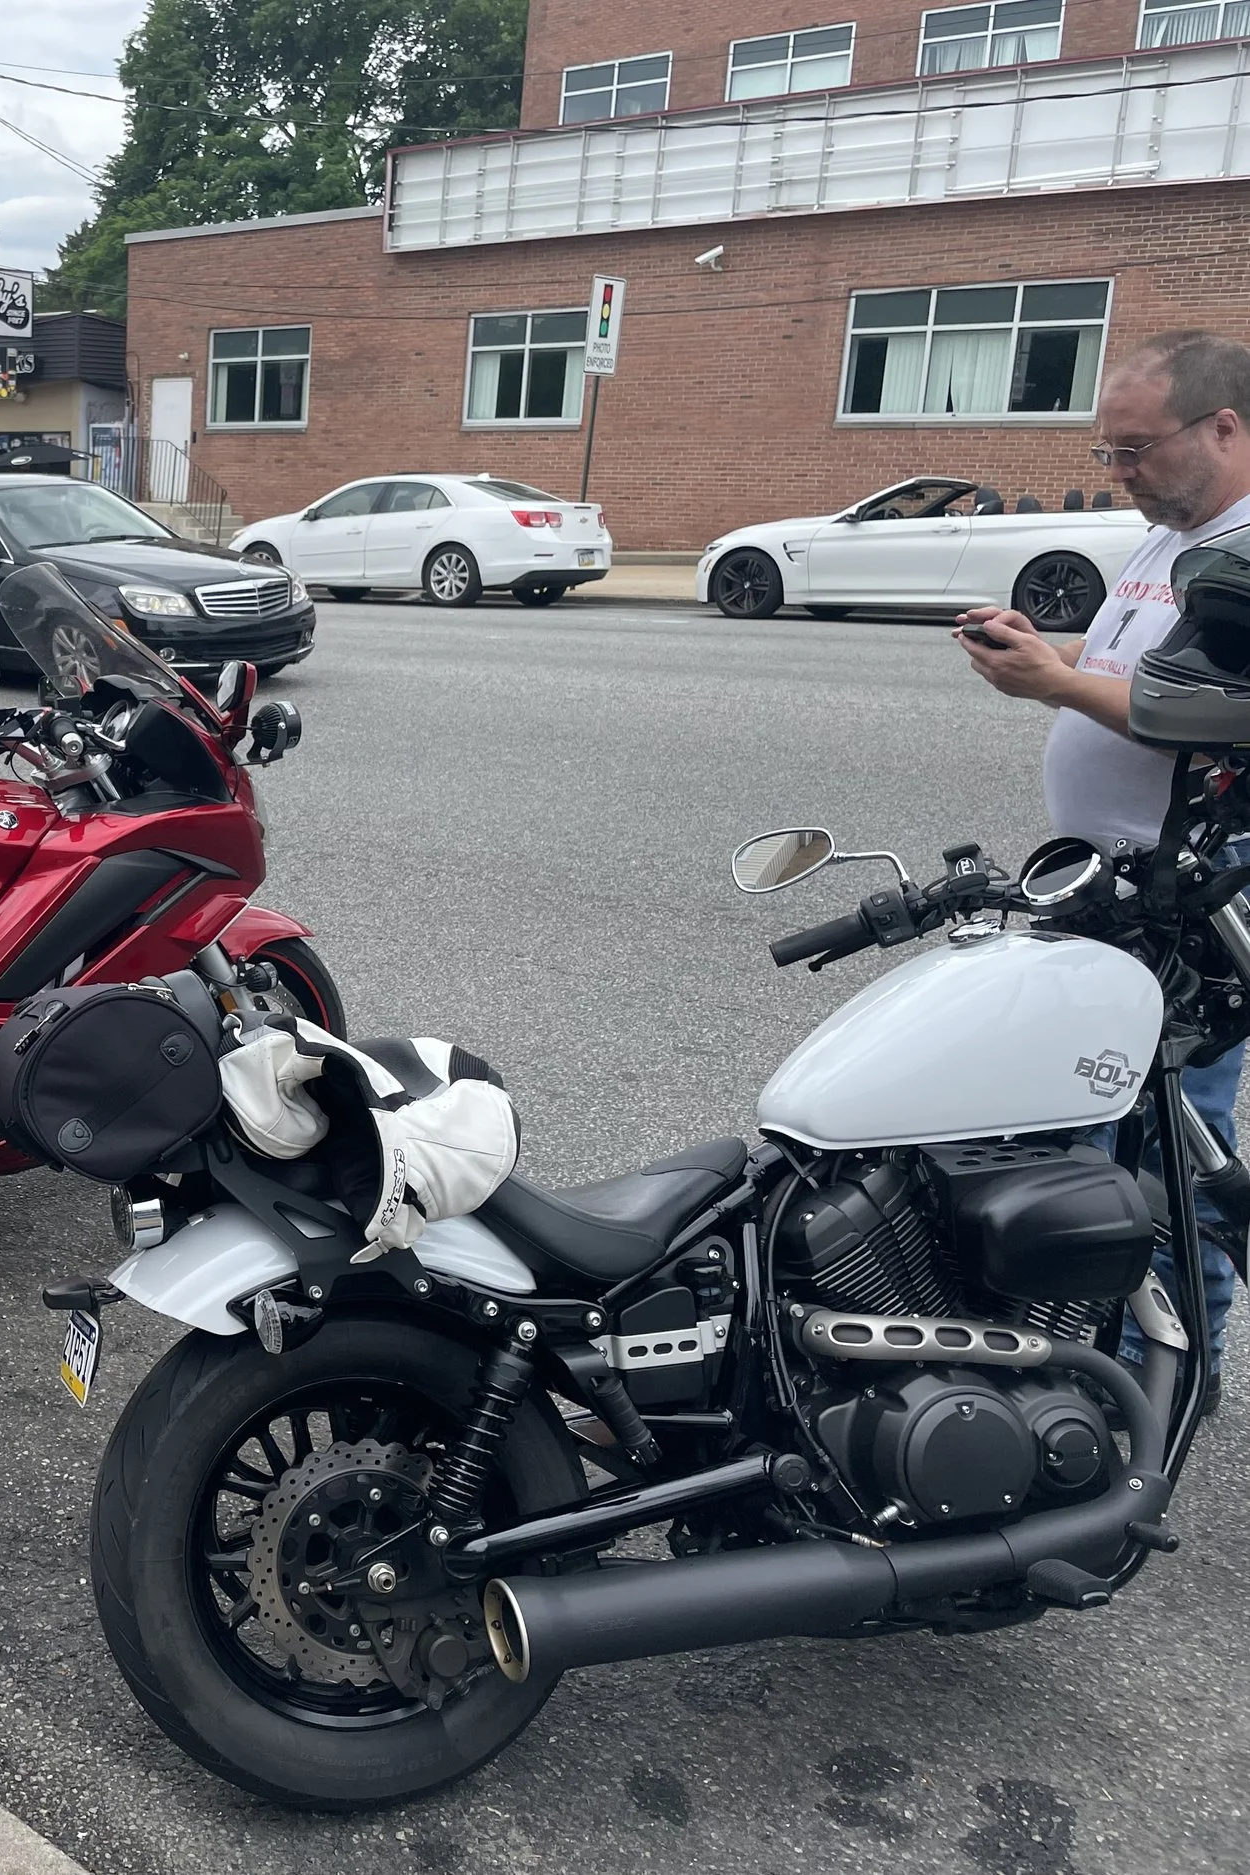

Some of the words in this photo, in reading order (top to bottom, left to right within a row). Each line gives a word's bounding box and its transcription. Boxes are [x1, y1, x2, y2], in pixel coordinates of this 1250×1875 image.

[593, 342, 611, 354] PHOTO
[586, 356, 614, 369] ENFORCED
[1073, 1056, 1141, 1089] BOLT
